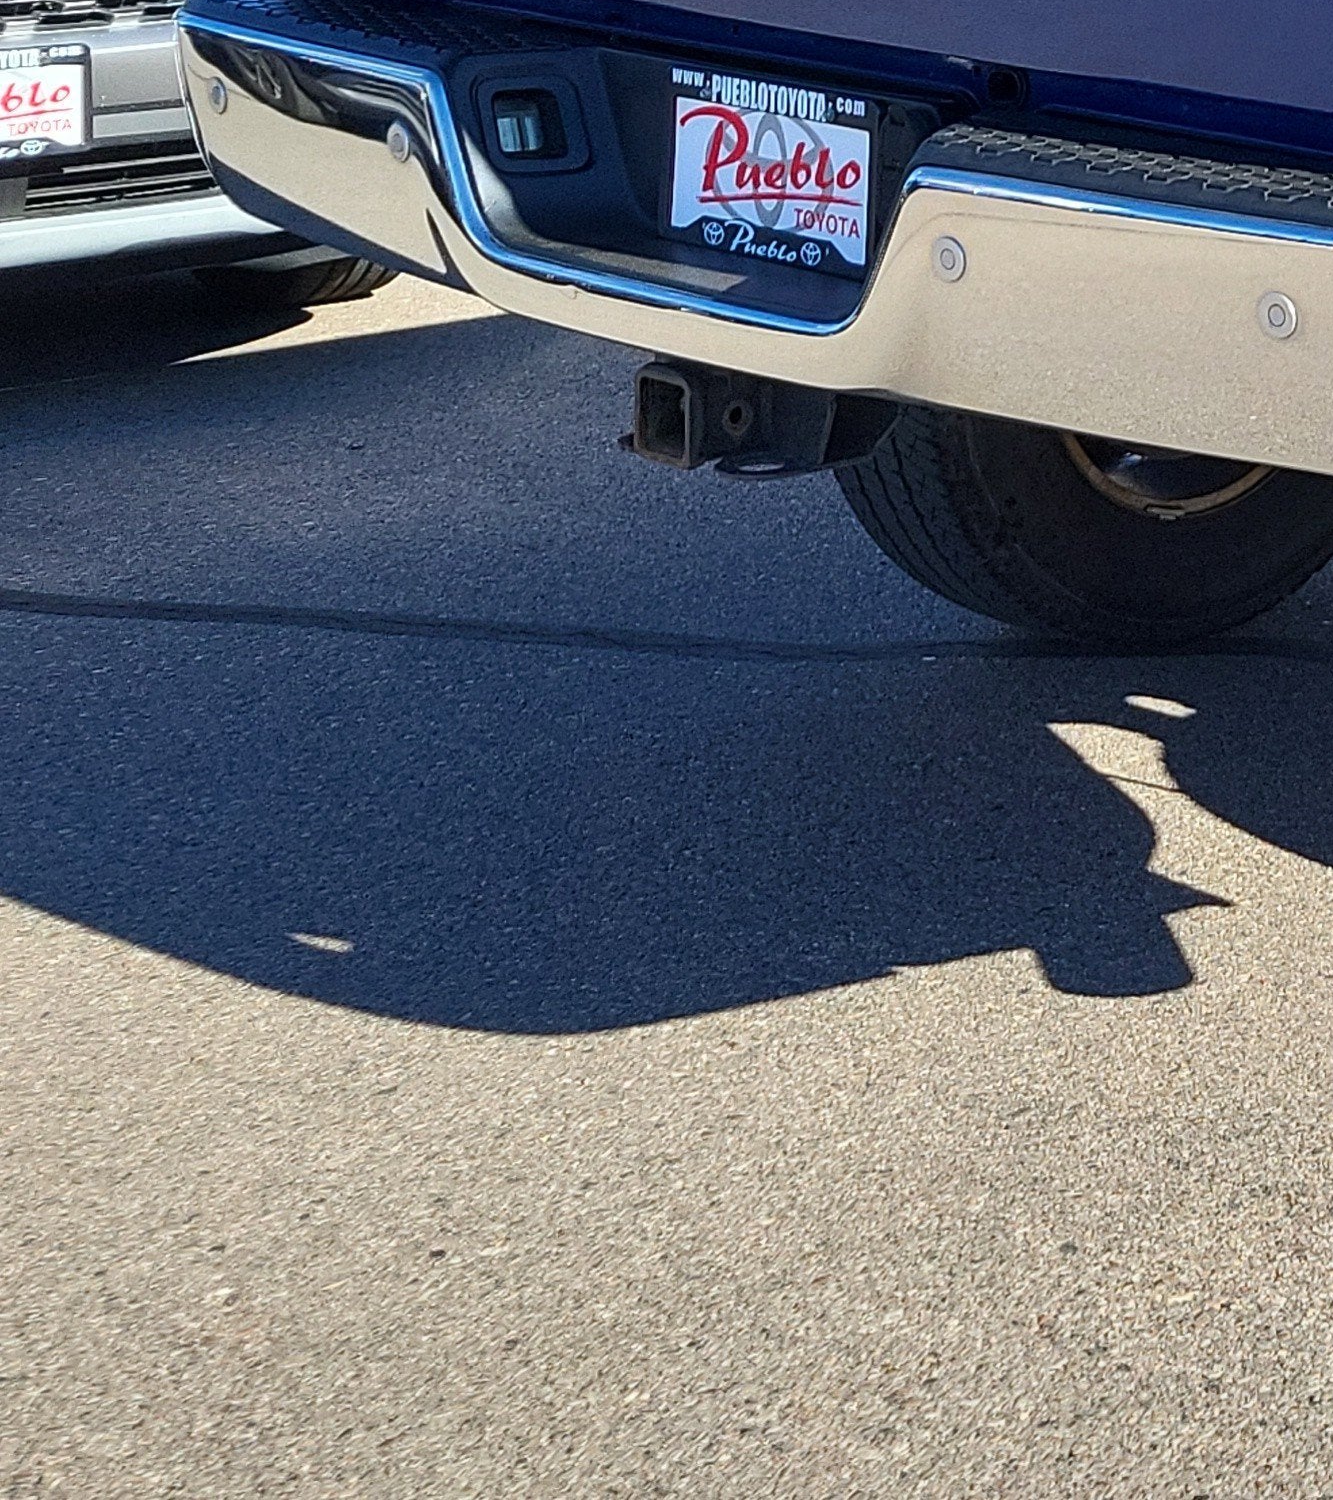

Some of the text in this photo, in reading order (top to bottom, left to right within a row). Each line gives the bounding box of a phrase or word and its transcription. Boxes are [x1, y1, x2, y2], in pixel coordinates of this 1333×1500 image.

[8, 119, 72, 137] TOYOTA
[680, 105, 861, 192] Pueblo
[794, 208, 861, 239] TOYOTA
[724, 221, 798, 263] Pueblo
